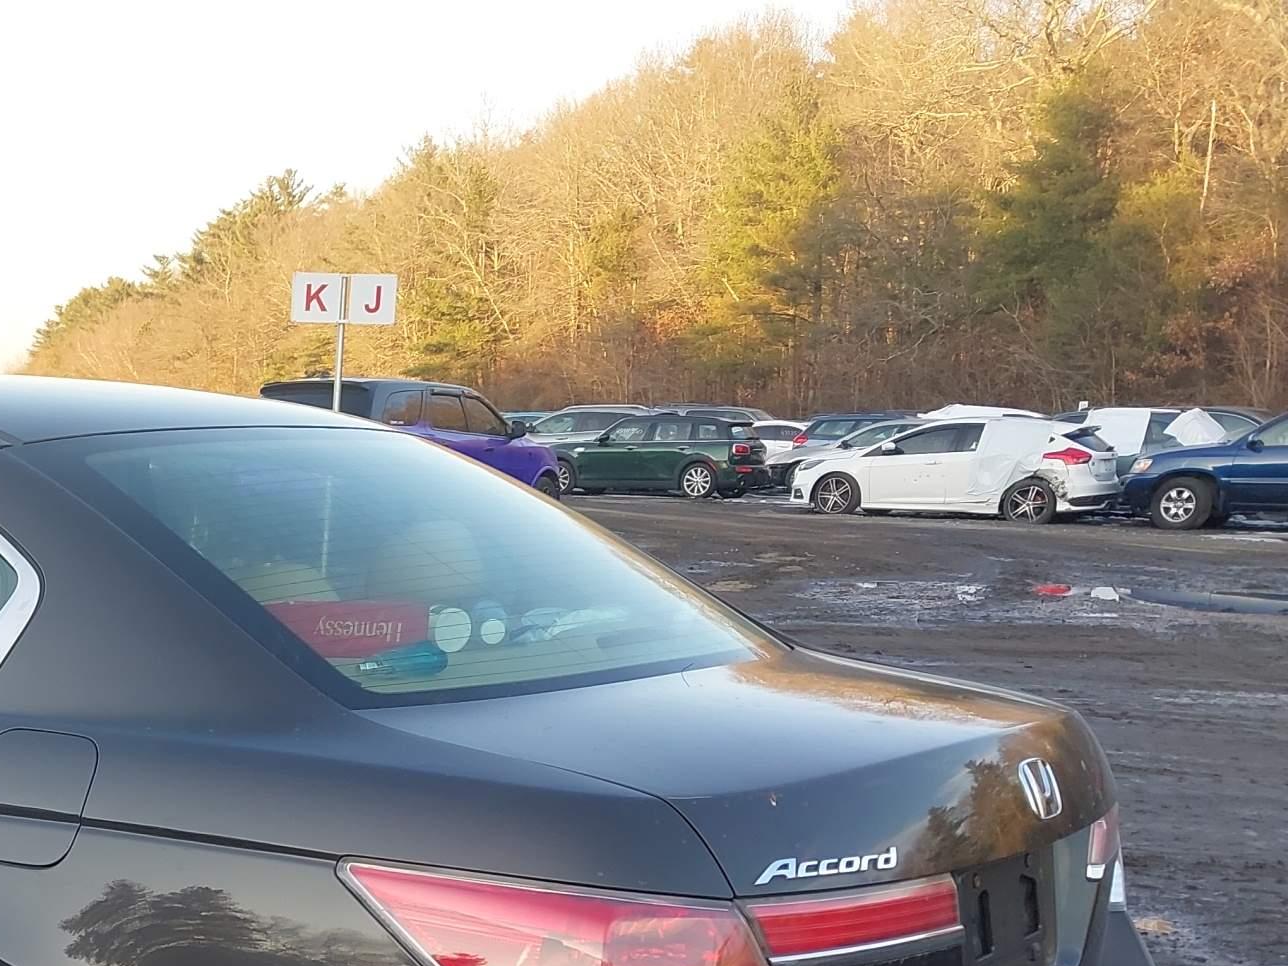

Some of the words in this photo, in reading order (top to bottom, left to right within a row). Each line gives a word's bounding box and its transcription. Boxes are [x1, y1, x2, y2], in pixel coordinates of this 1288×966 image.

[304, 283, 329, 312] K
[364, 285, 383, 314] J
[313, 615, 403, 643] Hennessy
[754, 846, 898, 886] Accord
